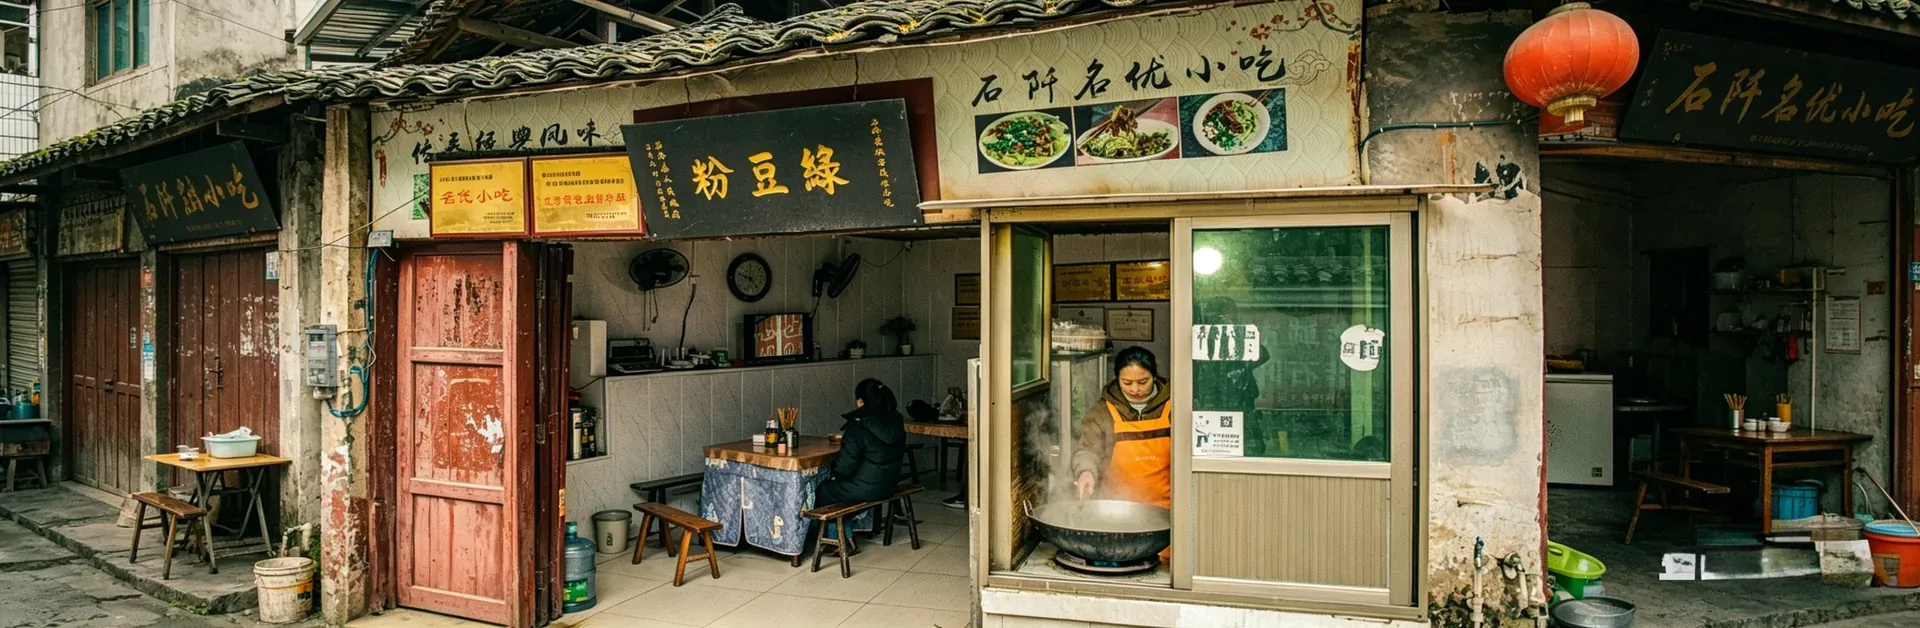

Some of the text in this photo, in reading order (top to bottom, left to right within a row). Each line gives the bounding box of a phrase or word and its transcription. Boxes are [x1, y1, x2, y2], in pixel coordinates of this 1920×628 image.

[972, 45, 1286, 107] 石阡名优小吃
[1665, 61, 1915, 138] 石阡名优小吃
